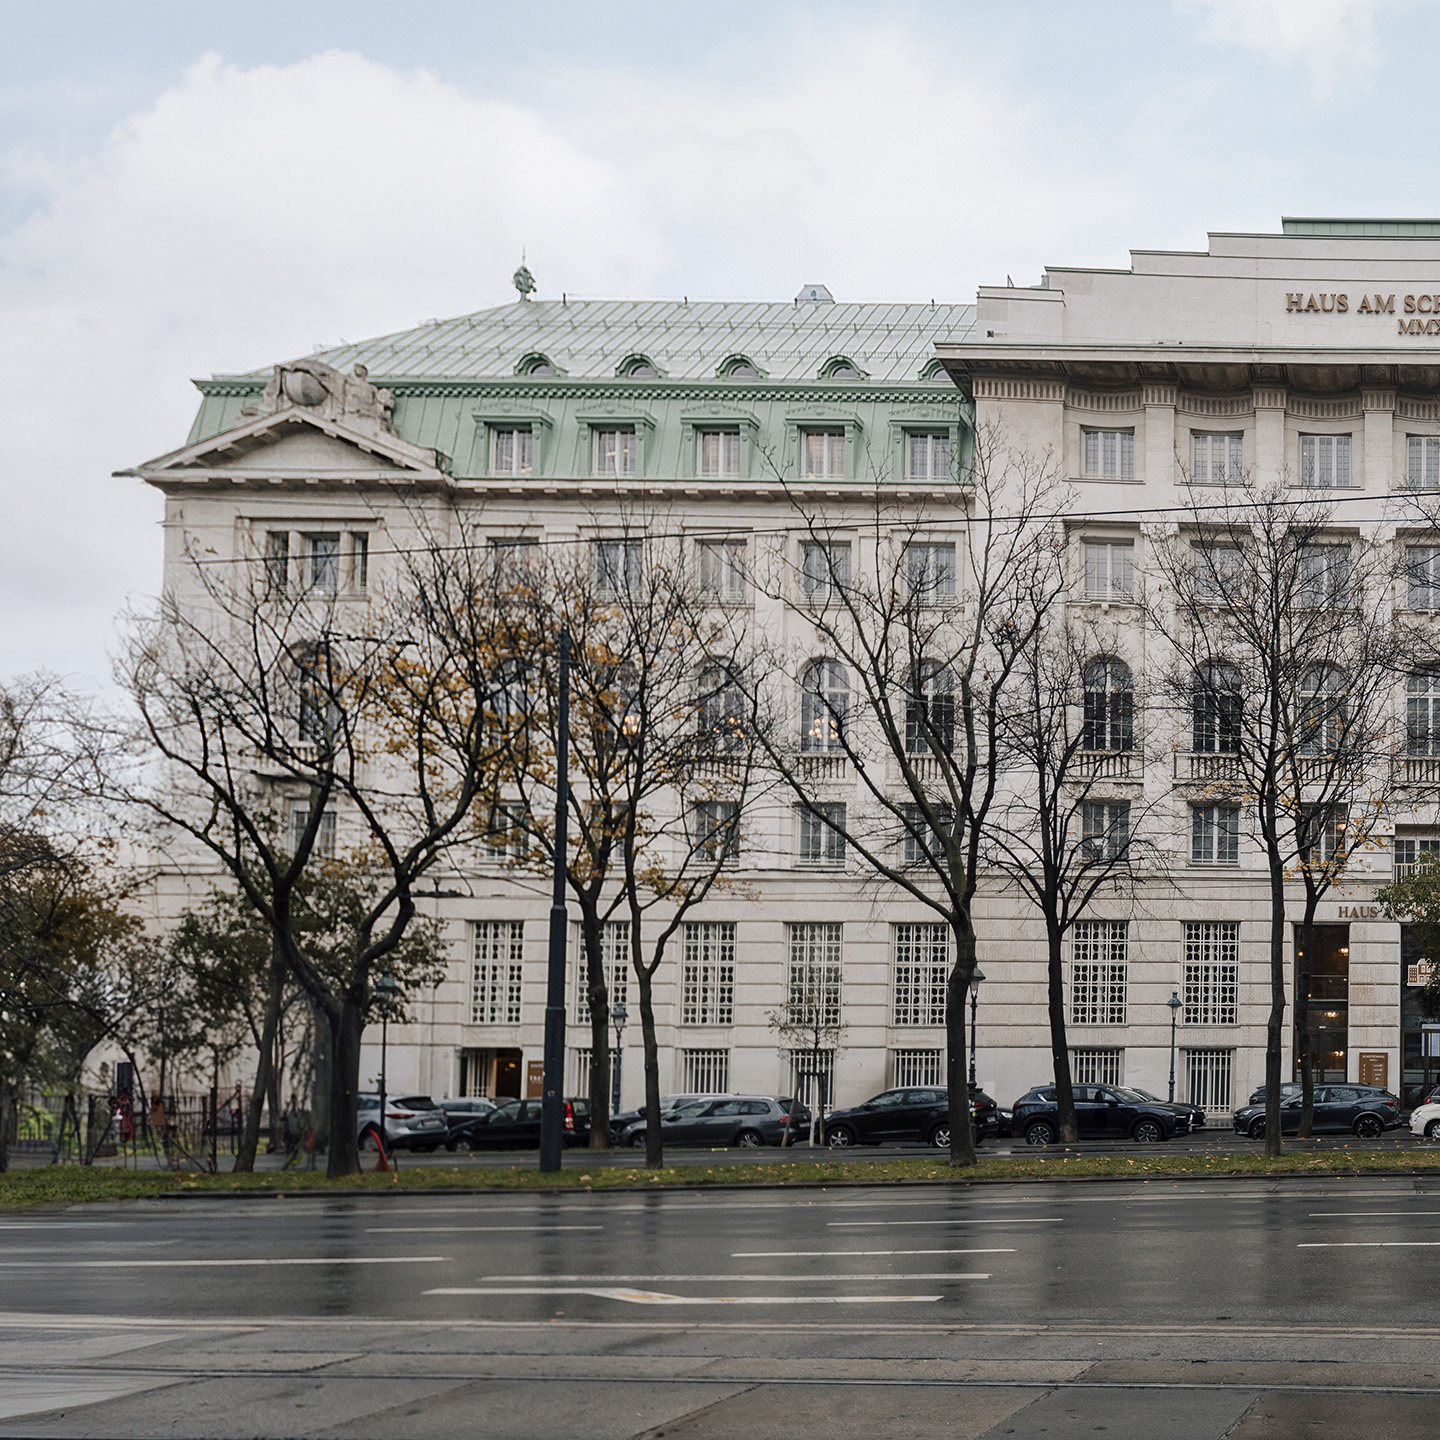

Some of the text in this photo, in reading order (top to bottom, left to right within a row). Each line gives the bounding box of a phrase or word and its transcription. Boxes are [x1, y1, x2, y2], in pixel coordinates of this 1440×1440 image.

[1286, 293, 1348, 312] HAUS
[1357, 293, 1395, 313] AM
[1338, 906, 1379, 918] HAUS
